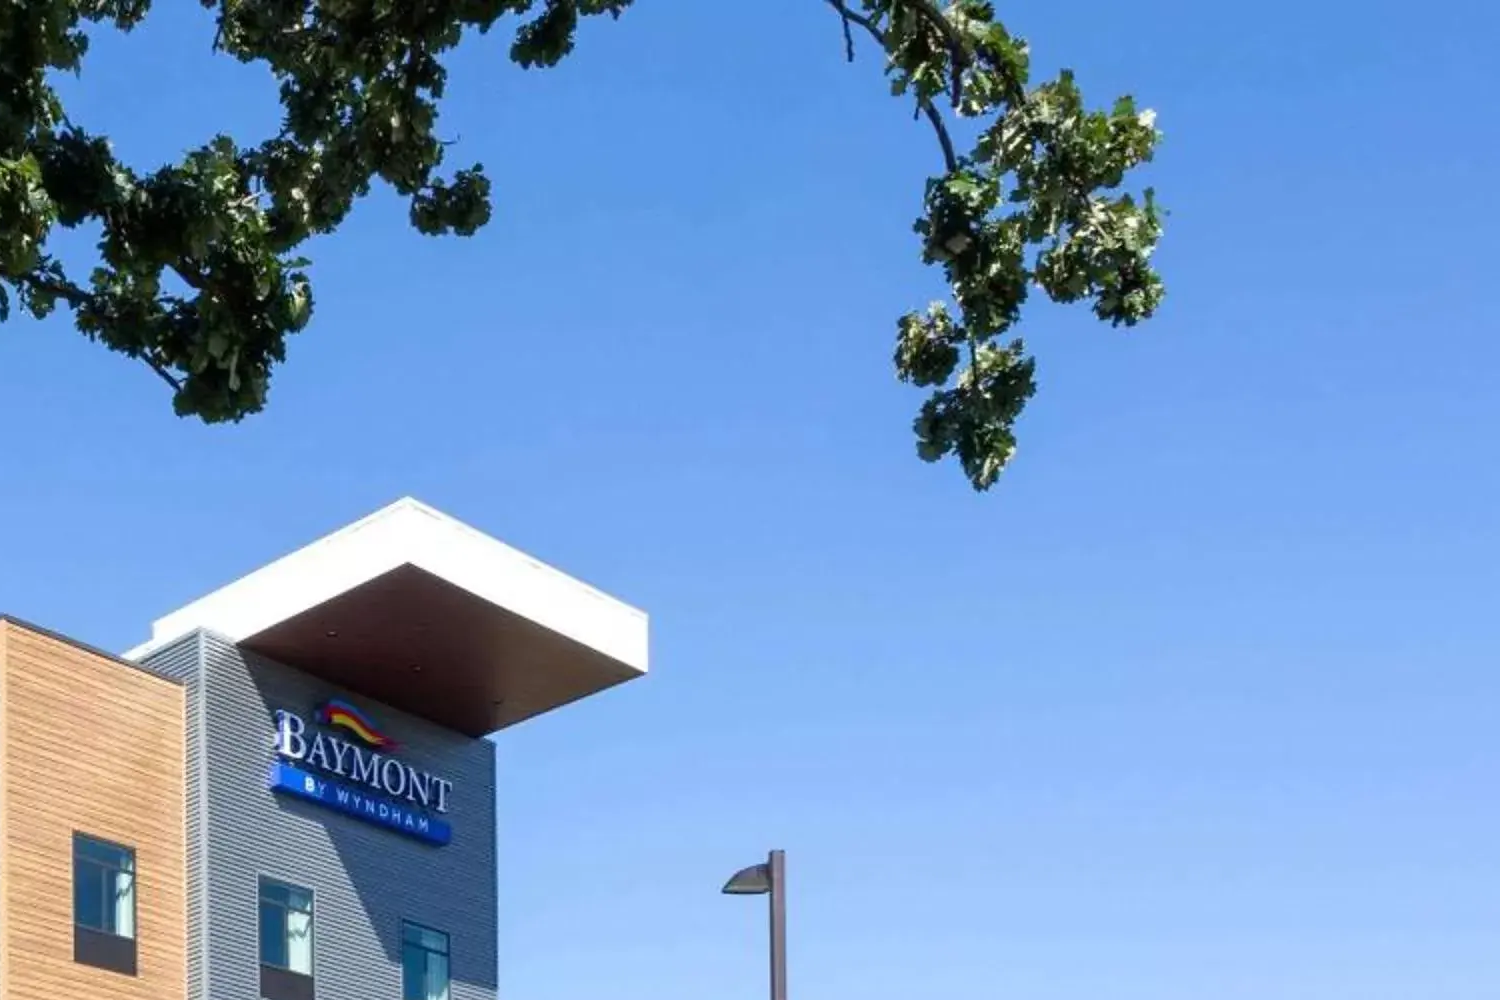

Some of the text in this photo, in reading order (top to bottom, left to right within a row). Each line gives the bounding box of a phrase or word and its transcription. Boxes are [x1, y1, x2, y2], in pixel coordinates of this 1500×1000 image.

[274, 709, 452, 813] BAYMONT
[304, 776, 429, 832] BY WYNDHAM
